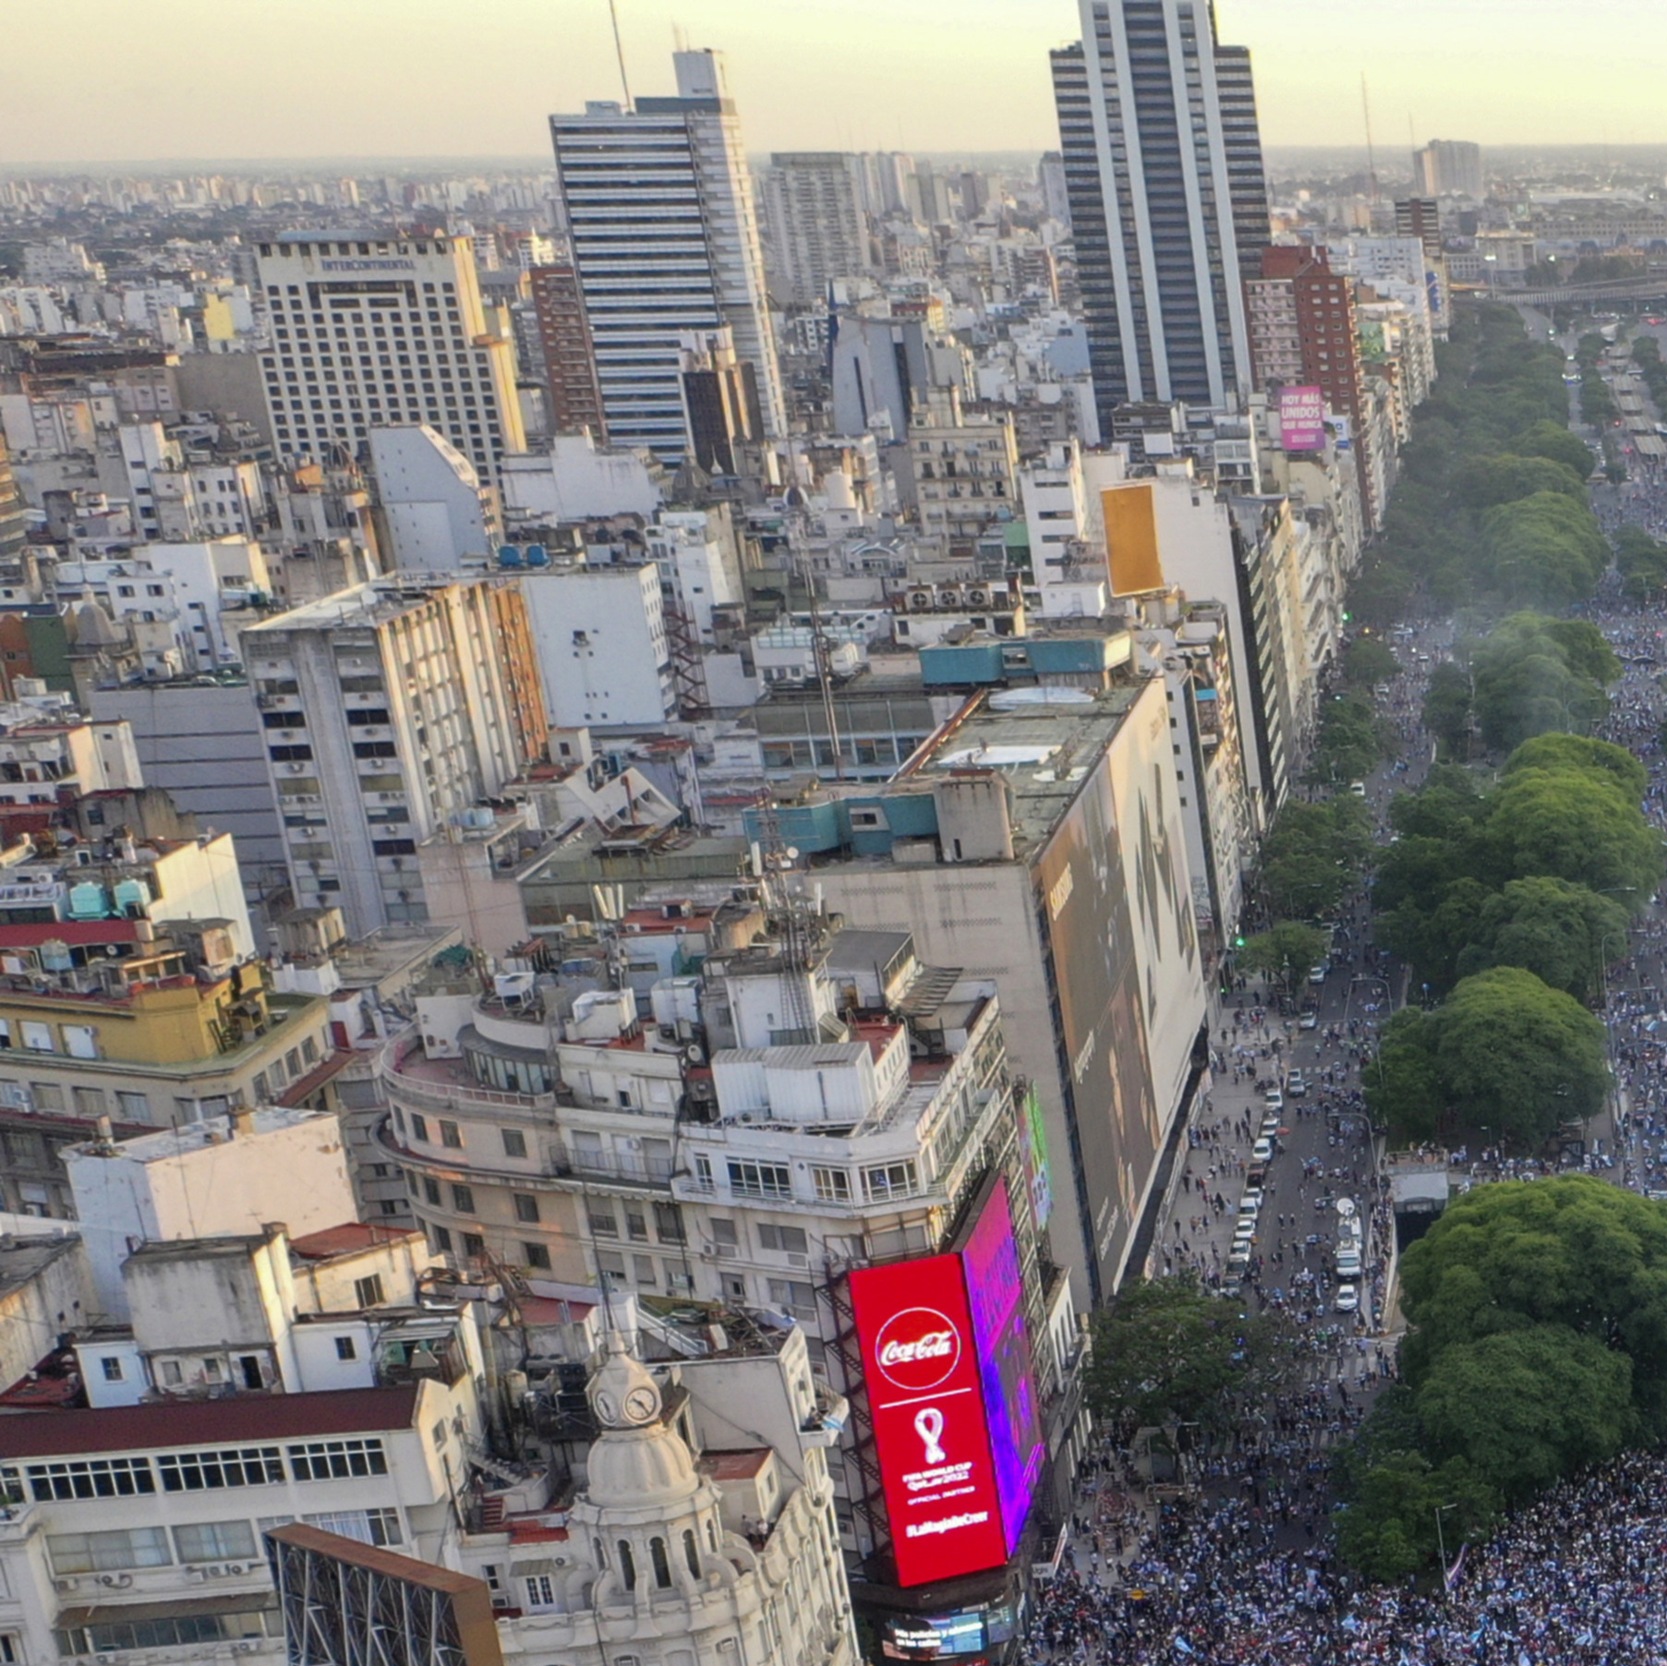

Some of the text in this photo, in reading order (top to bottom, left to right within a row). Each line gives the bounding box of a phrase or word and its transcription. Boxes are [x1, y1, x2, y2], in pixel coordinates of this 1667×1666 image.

[1281, 395, 1300, 405] HOY
[1281, 406, 1320, 419] UNIDOS
[881, 1330, 953, 1366] Coca-Cola
[903, 1461, 973, 1483] FIFA WORLD CUP
[907, 1486, 976, 1505] OFFICIAL PARTNER
